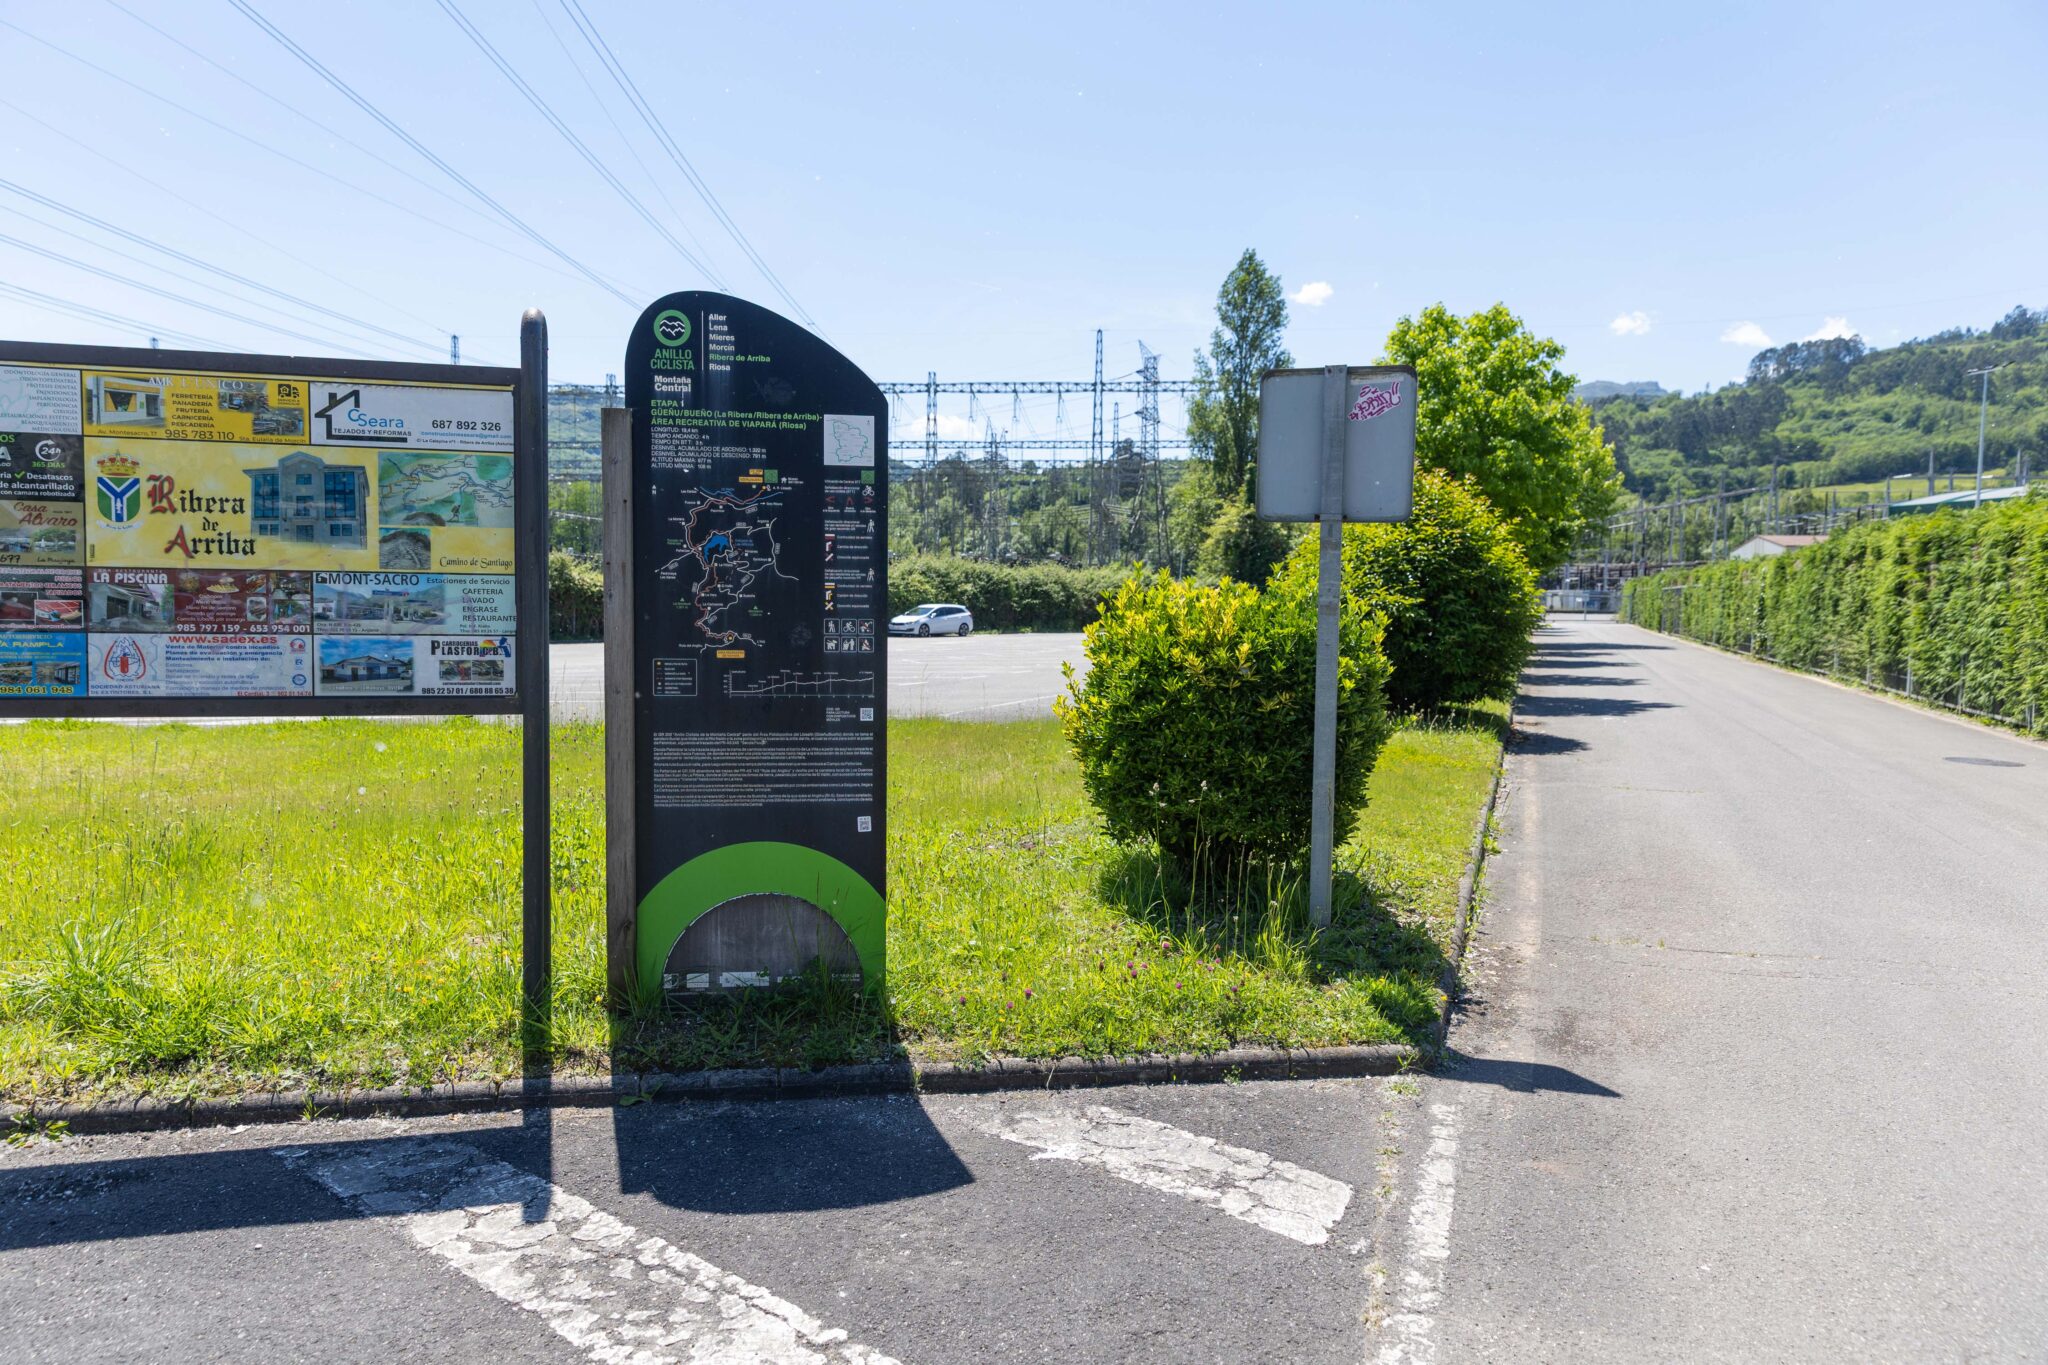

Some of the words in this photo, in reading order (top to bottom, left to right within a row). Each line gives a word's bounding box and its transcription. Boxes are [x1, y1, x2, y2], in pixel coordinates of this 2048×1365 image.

[708, 322, 728, 331] Lena
[654, 349, 692, 360] ANILLO
[747, 354, 771, 362] Arriba
[650, 359, 695, 370] CICLISTA
[654, 375, 692, 384] Montaña
[654, 383, 692, 392] Central
[651, 408, 712, 417] GÜEÑU/BUEÑO
[714, 410, 726, 418] (La
[728, 411, 781, 420] Ribera/Ribera
[432, 420, 452, 429] 687
[456, 421, 477, 430] 892
[480, 422, 501, 431] 326
[651, 417, 674, 425] ÁREA
[779, 422, 806, 430] (Riosa)
[165, 429, 188, 439] 985
[192, 430, 214, 439] 783
[218, 431, 234, 440] 110
[12, 481, 74, 490] alcantarillado
[146, 474, 245, 514] Ribera
[14, 502, 48, 512] Casa
[202, 517, 219, 532] de
[164, 524, 256, 559] Arriba
[440, 556, 468, 567] Camino
[470, 557, 478, 566] de
[480, 558, 513, 570] Santiago
[93, 572, 110, 582] LA
[115, 573, 168, 583] PISCINA
[329, 573, 420, 586] MONT-SACRO
[169, 635, 278, 644] www.sadex.es
[0, 686, 22, 694] 984
[25, 686, 47, 694] 061
[51, 686, 74, 694] 948
